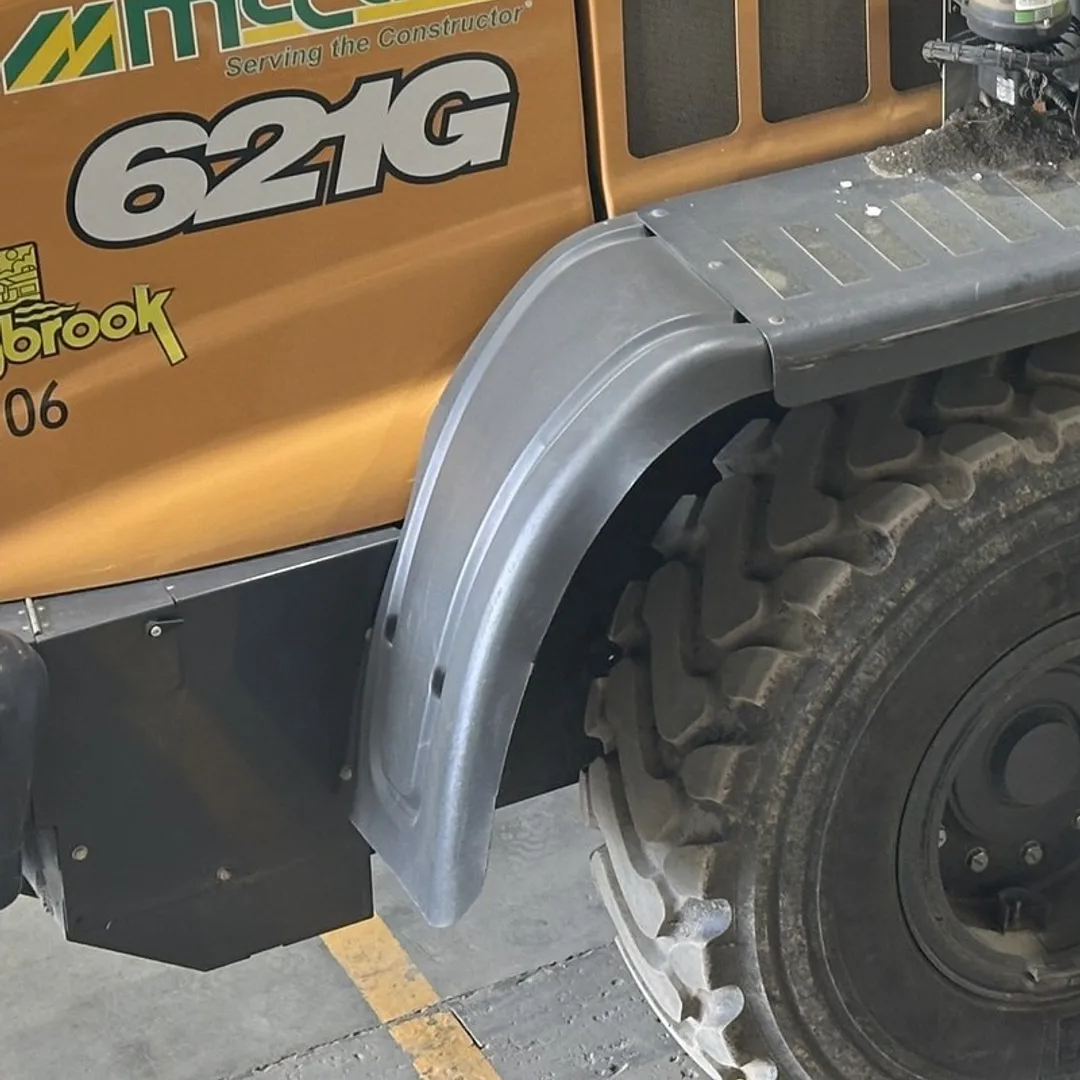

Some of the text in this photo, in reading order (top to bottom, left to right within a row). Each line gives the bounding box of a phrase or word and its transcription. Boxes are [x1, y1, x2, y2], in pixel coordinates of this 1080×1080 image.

[224, 5, 525, 78] Serving the Constructor
[65, 51, 520, 250] 621G
[0, 284, 188, 380] brook
[4, 379, 69, 438] 06
